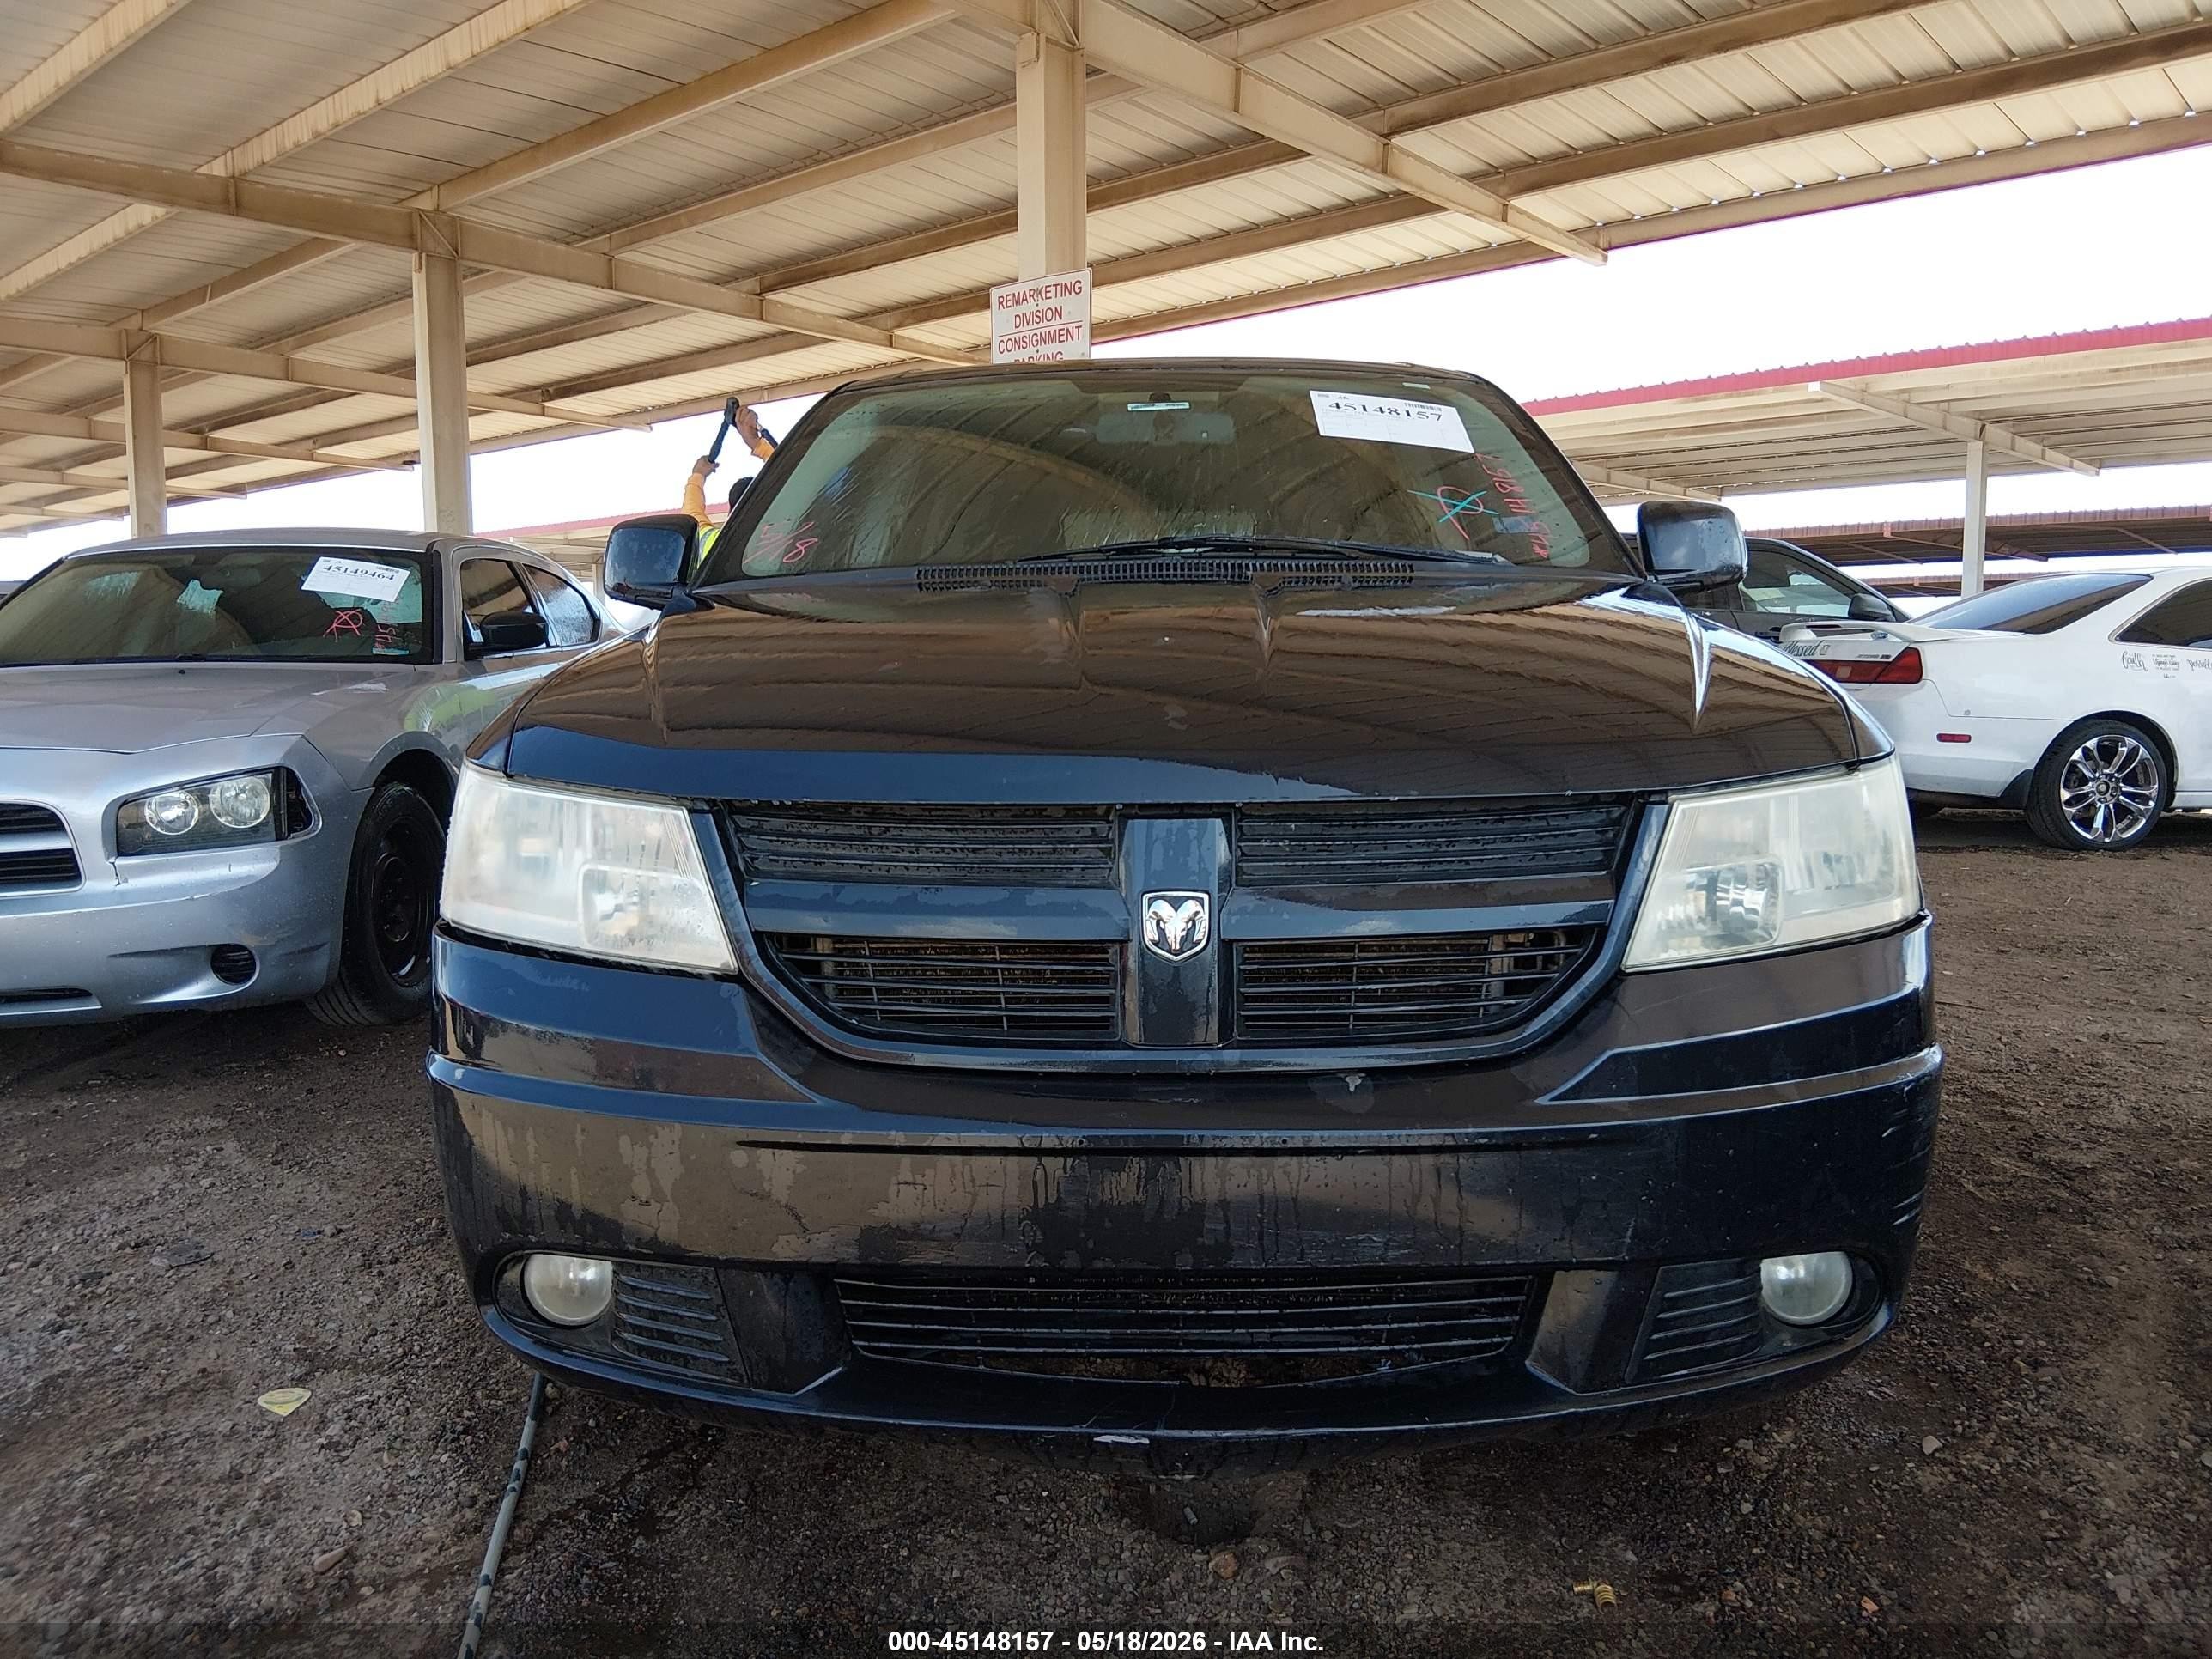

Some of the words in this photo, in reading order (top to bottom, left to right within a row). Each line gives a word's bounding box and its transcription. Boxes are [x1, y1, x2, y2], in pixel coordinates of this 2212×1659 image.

[998, 280, 1083, 310] REMARKETING
[1014, 306, 1063, 329] DIVISION
[998, 325, 1083, 354] CONSIGNMENT
[1014, 350, 1064, 362] KING
[1328, 401, 1443, 422] 45148157
[323, 564, 395, 581] 45149464
